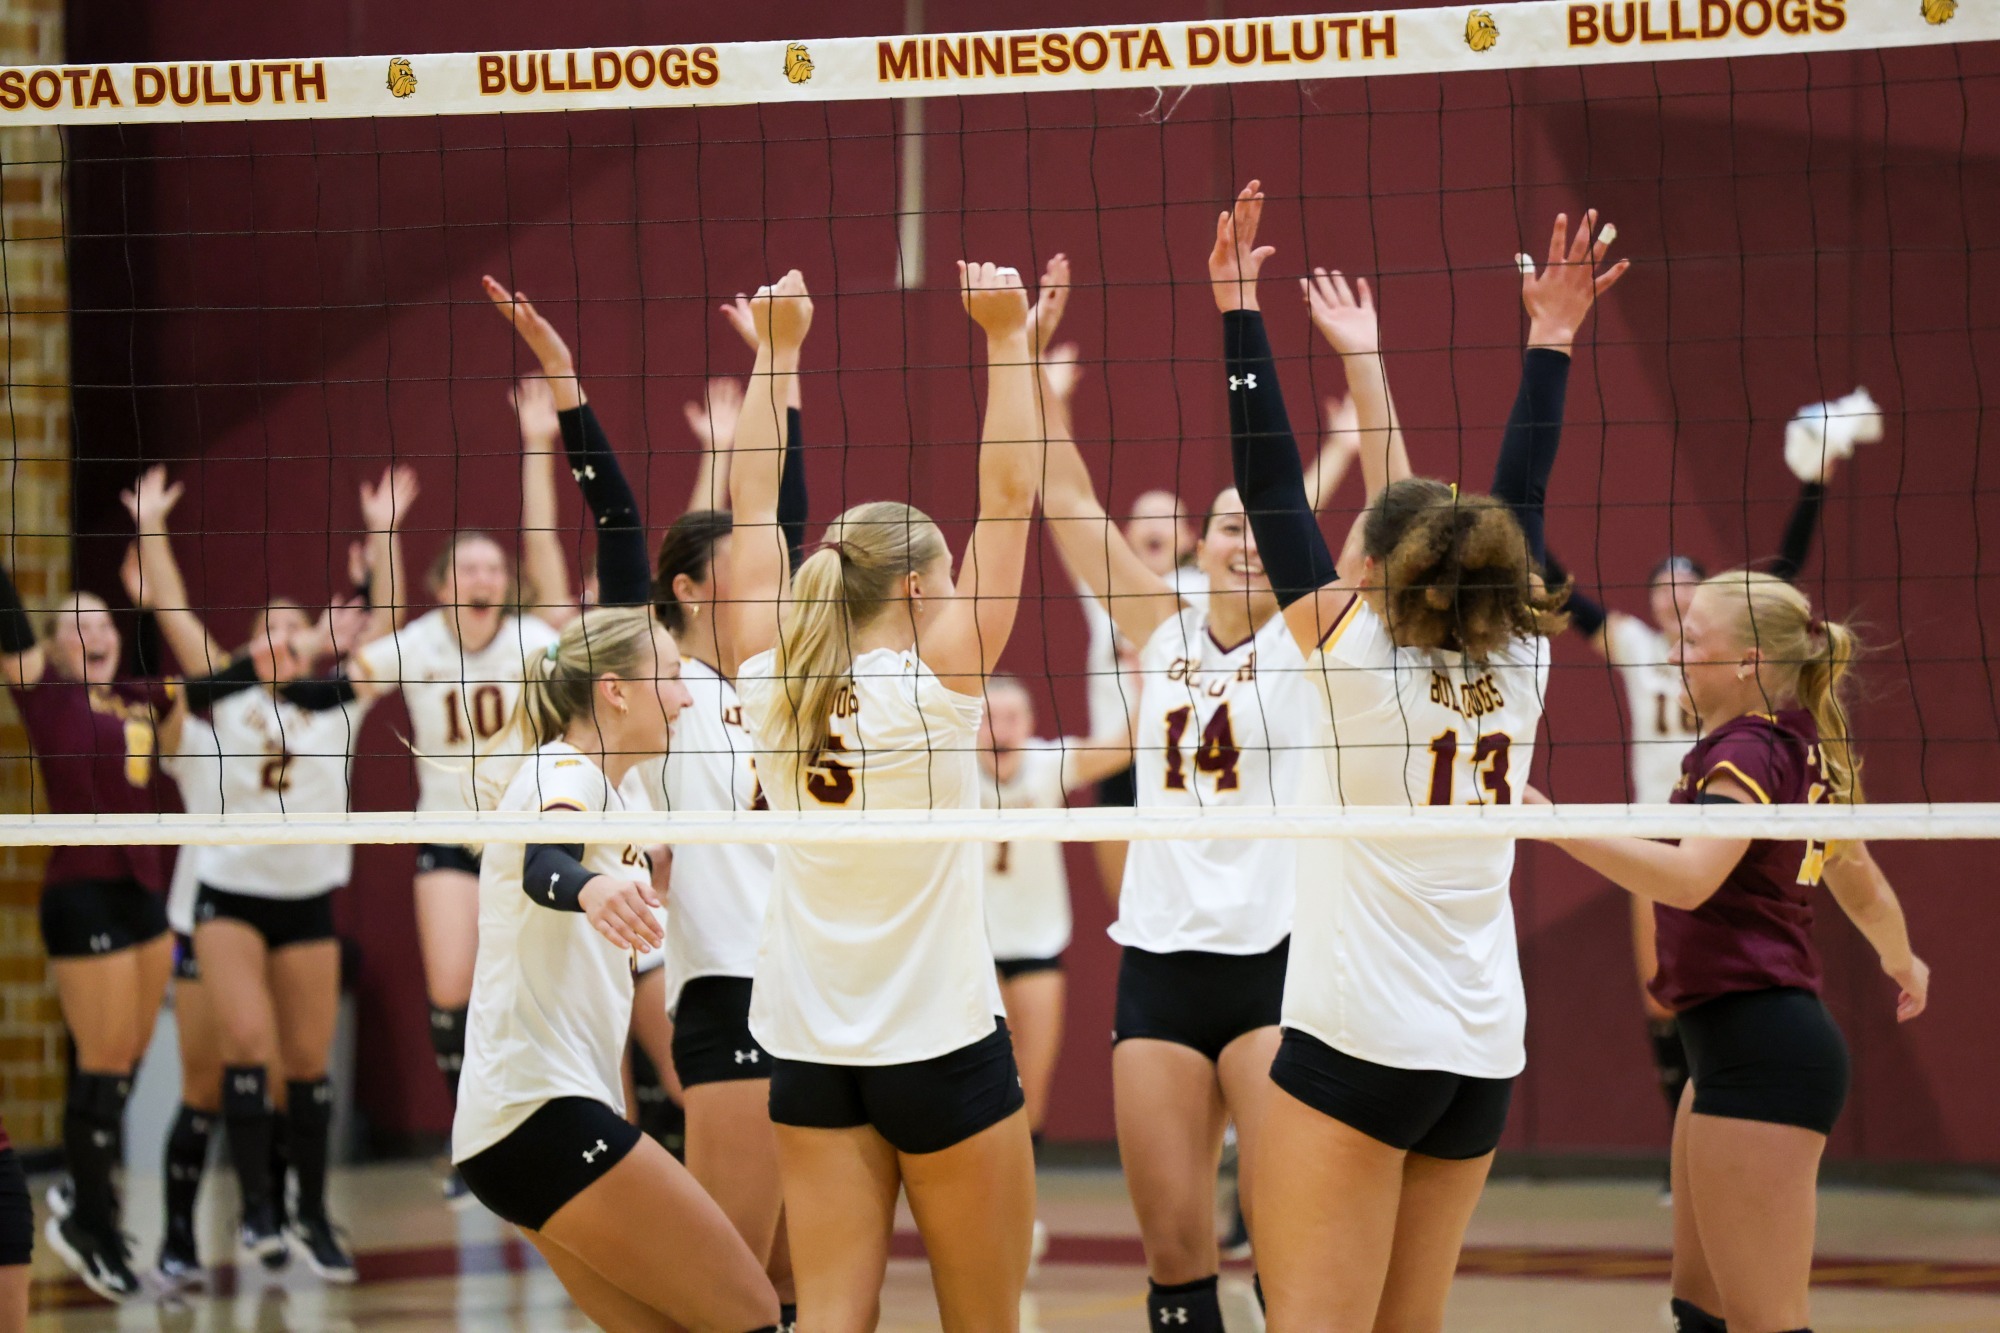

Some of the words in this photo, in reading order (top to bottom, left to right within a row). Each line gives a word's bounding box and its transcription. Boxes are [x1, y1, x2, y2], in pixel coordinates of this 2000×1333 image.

[876, 26, 1174, 83] MINNESOTA
[1186, 16, 1398, 69] DULUTH
[1567, 0, 1848, 48] BULLDOGS
[0, 67, 124, 112] SOTA
[132, 61, 328, 107] DULUTH
[478, 46, 719, 96] BULLDOGS
[443, 685, 505, 745] 10
[1164, 701, 1240, 793] 14
[1426, 726, 1513, 806] 13
